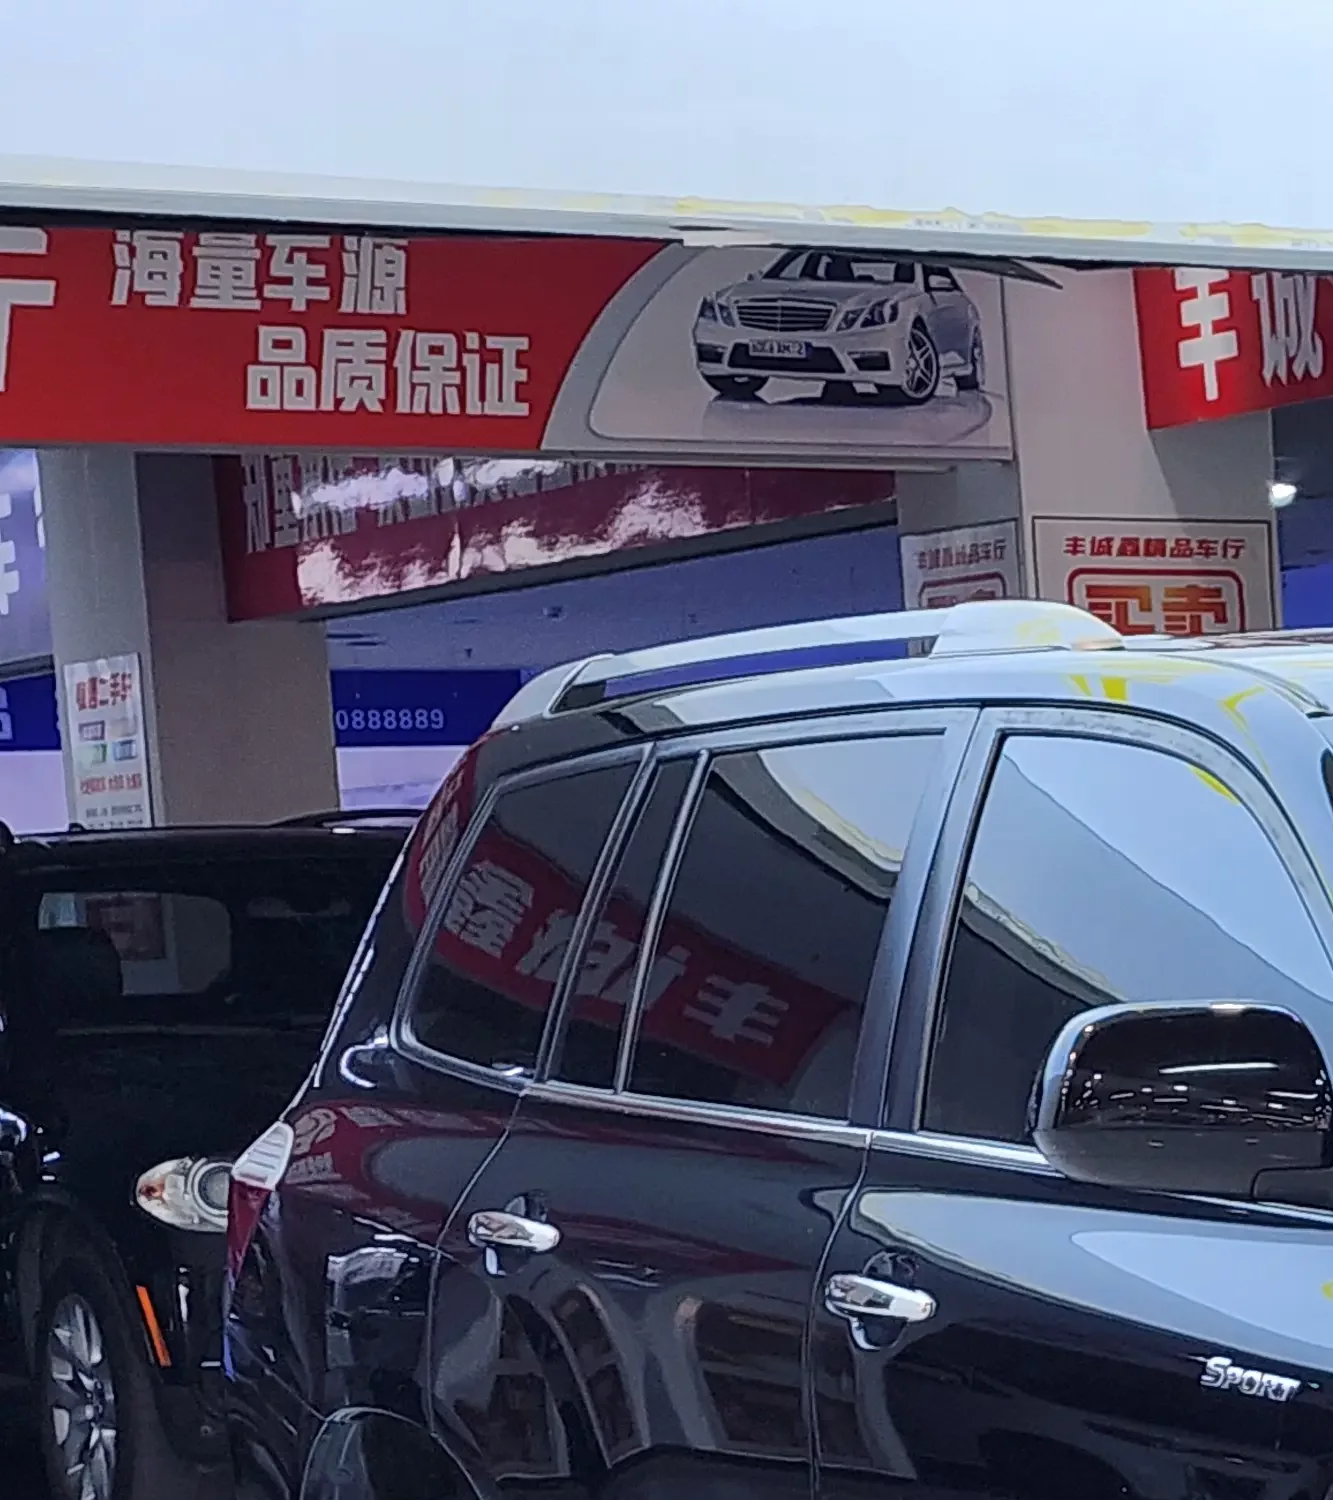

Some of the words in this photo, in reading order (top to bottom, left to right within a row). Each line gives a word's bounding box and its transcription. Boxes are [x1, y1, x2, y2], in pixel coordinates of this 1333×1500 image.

[110, 229, 408, 315] 海量车源
[246, 325, 529, 416] 品质保证
[335, 708, 444, 730] 0888889
[1200, 1356, 1302, 1402] SPORT
